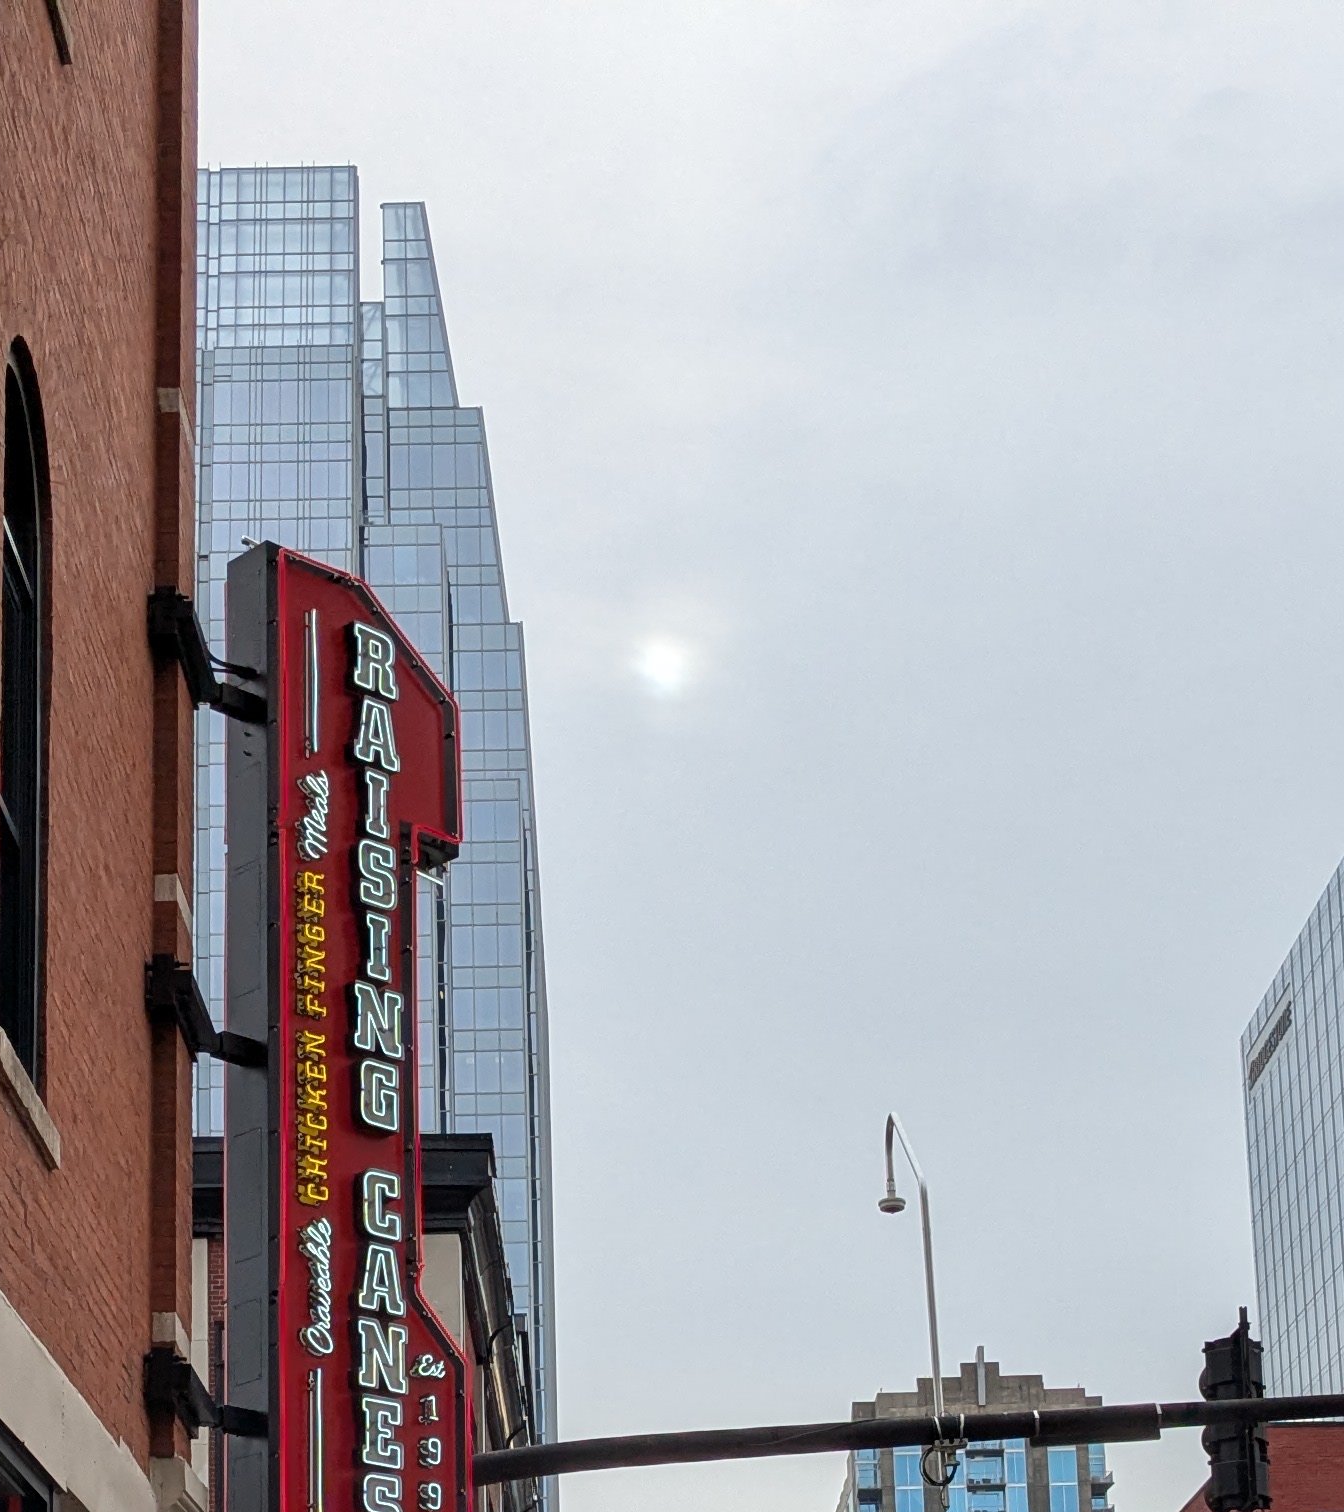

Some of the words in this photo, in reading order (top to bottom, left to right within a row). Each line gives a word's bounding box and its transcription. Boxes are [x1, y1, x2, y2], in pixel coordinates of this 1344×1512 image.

[300, 767, 330, 861] Meals
[352, 620, 404, 1133] RAISING
[302, 871, 327, 1017] FINGER
[304, 1030, 329, 1205] CHICKEN
